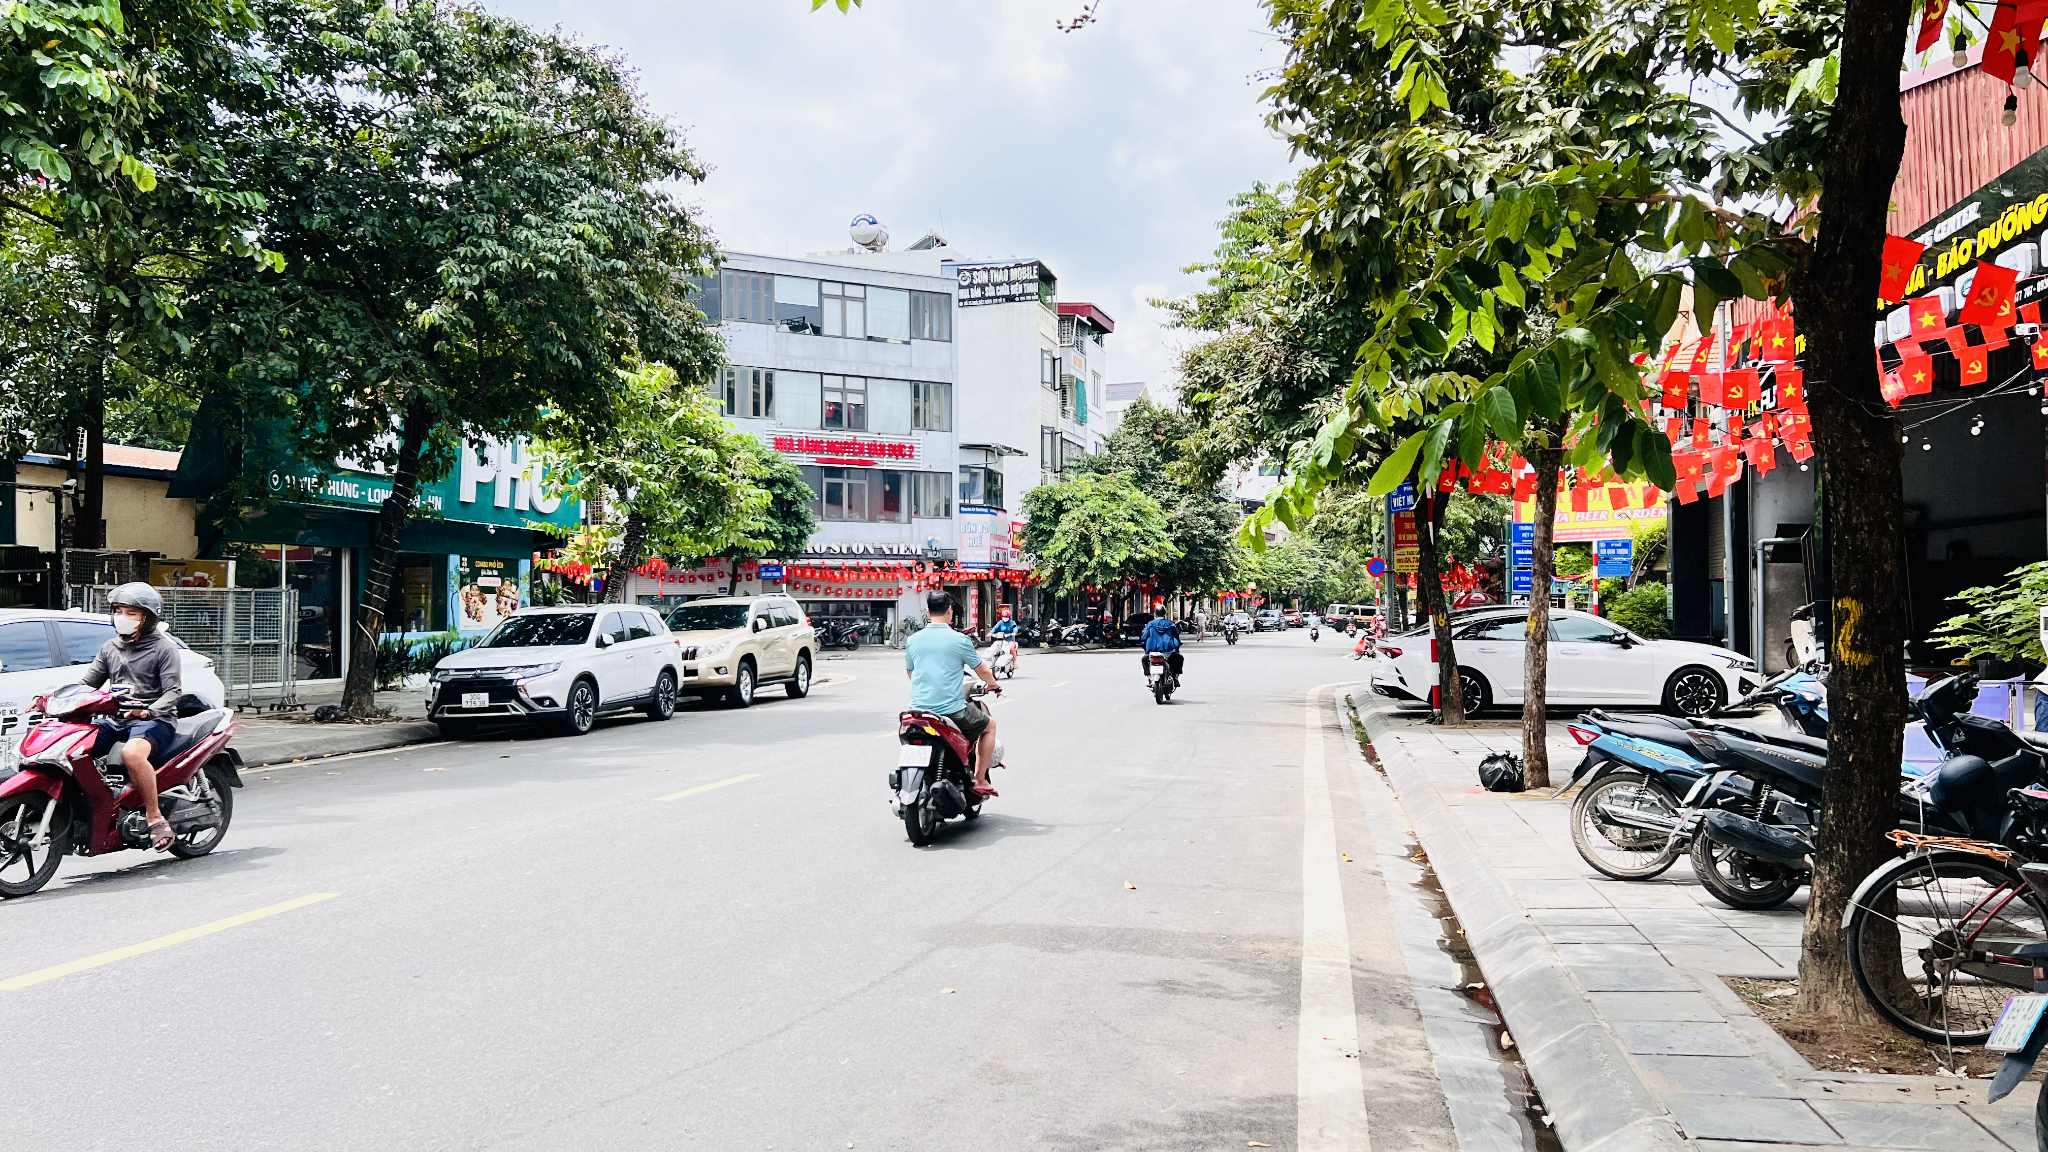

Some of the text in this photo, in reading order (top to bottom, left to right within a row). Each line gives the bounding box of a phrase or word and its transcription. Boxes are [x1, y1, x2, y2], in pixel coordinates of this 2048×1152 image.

[1937, 237, 1972, 279] BẢO
[1976, 193, 2048, 257] DƯỠNG
[328, 479, 359, 499] HƯNG
